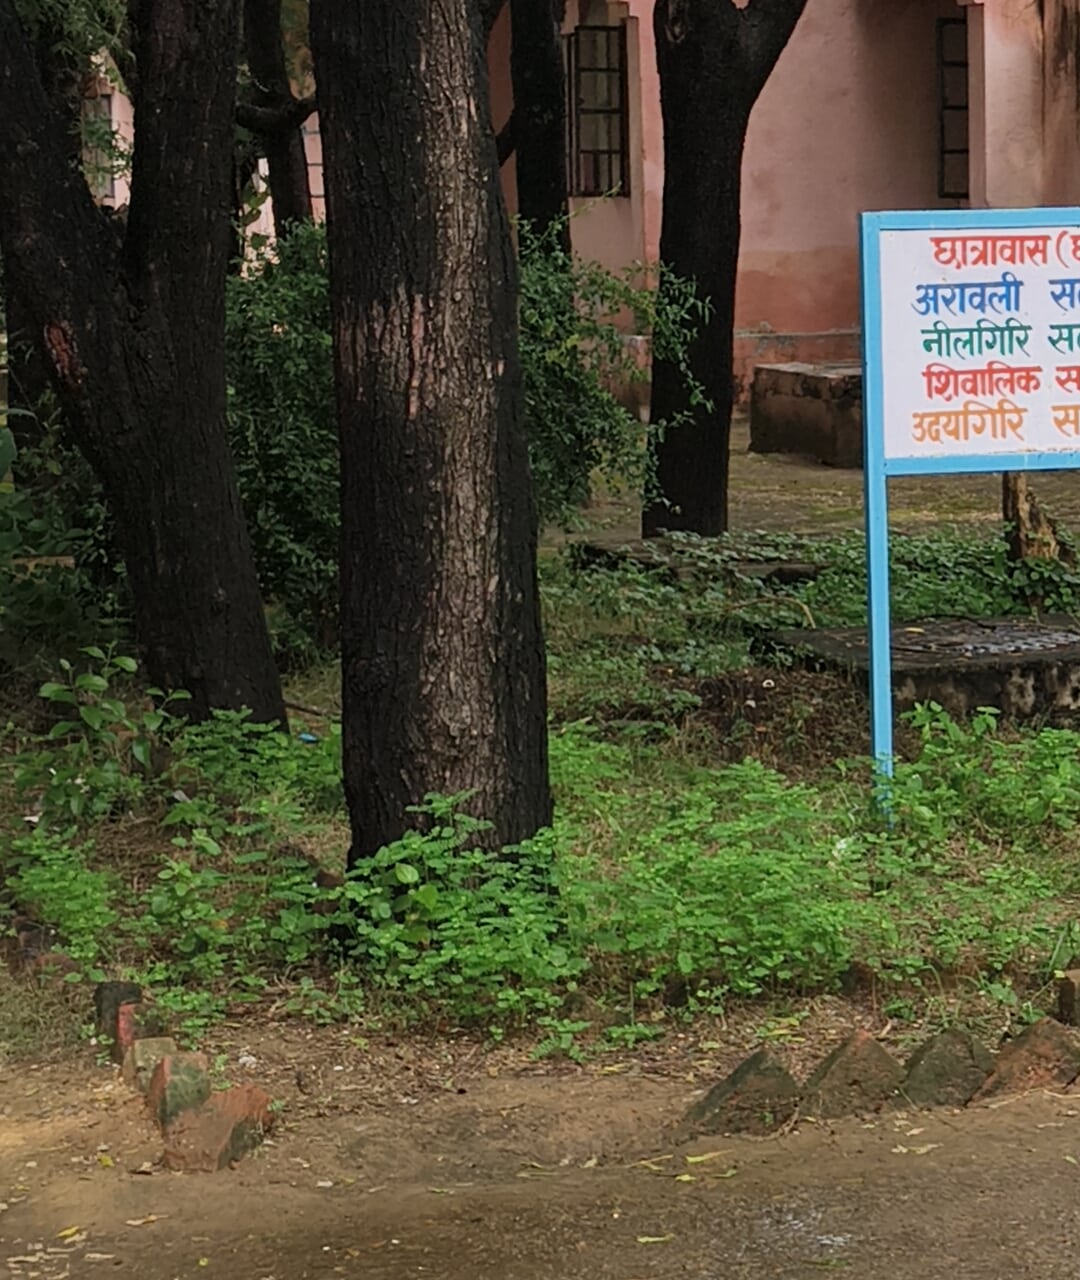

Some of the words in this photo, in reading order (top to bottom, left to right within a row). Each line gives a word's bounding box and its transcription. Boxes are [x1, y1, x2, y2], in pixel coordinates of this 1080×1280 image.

[912, 272, 1024, 316] अरावली
[921, 318, 1033, 360] नीलगिरि
[922, 362, 1043, 402] शिवालिक
[912, 399, 1028, 443] उदयगिरि
